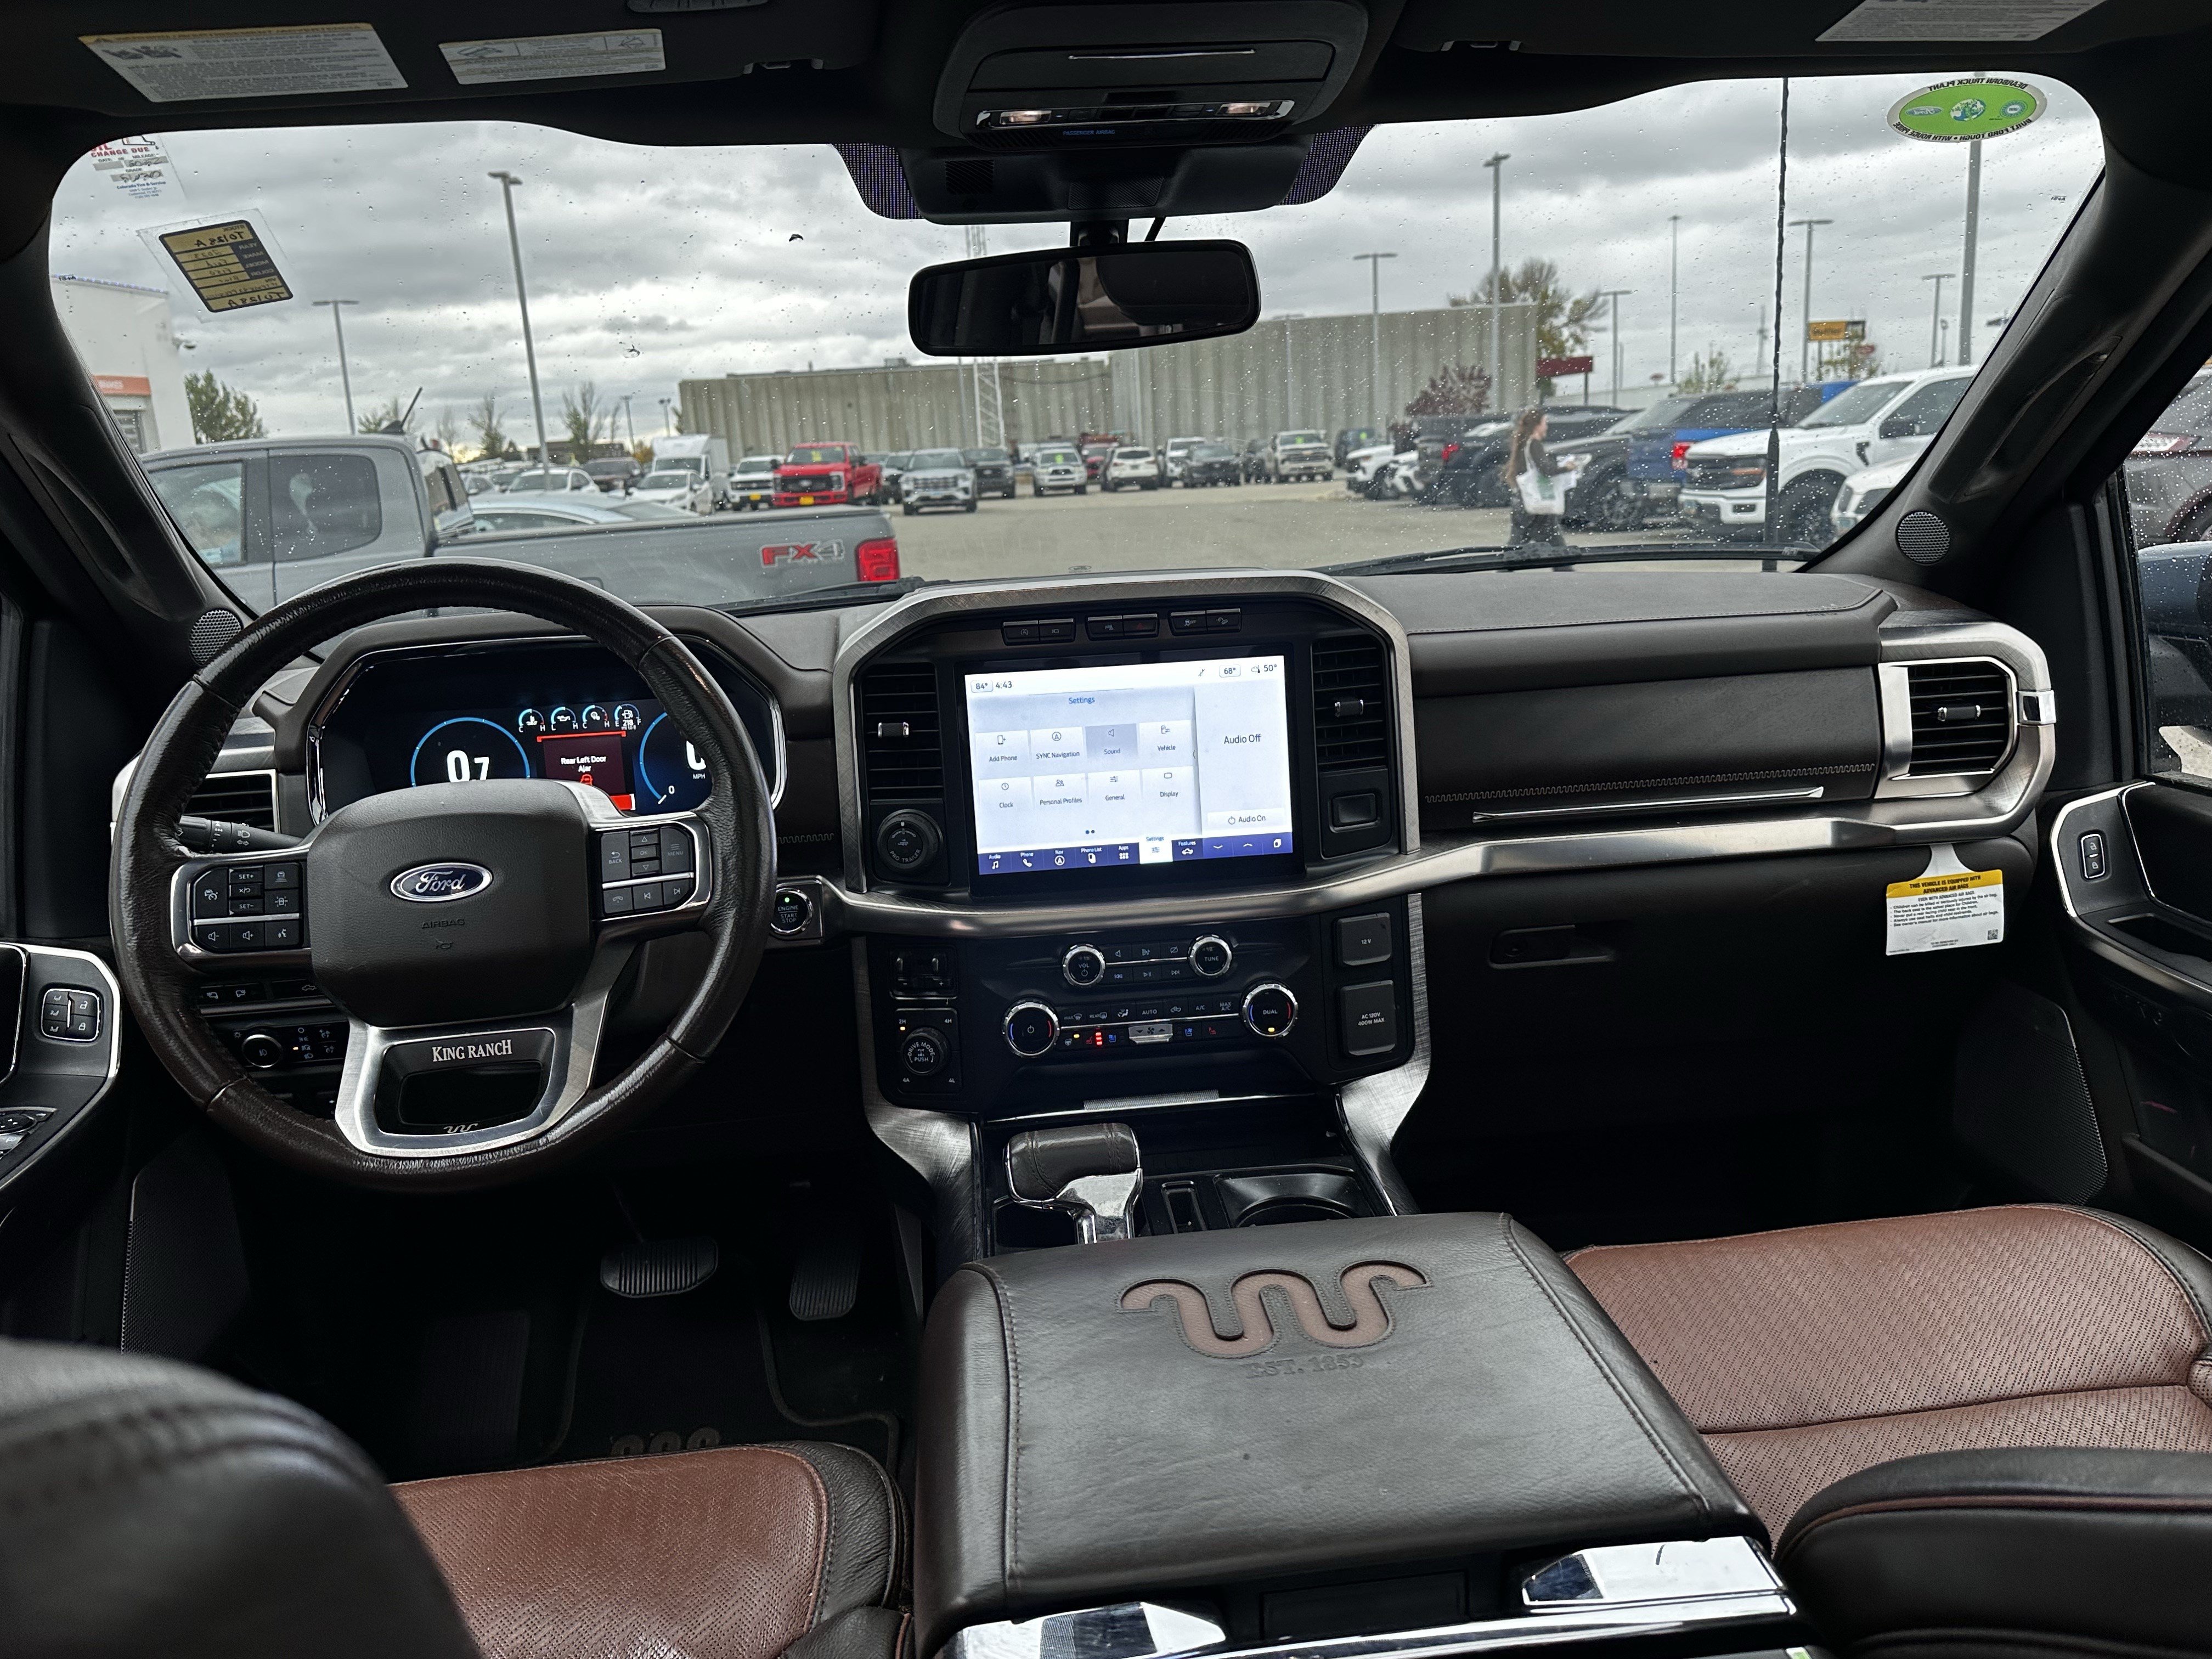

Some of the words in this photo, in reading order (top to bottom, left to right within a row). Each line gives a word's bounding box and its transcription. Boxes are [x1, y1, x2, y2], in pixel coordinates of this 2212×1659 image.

[91, 149, 128, 157] CHANGE
[759, 540, 845, 568] FX4
[995, 681, 1012, 689] 4:43
[1224, 735, 1247, 744] Audio
[1248, 734, 1261, 743] Off
[1051, 751, 1080, 759] Navigation
[447, 750, 489, 782] 07
[668, 785, 675, 794] 0
[890, 850, 900, 861] PRO
[901, 849, 921, 862] TRAILER
[415, 871, 466, 893] Ford
[421, 918, 466, 929] AIRBAG
[432, 1046, 465, 1062] KING
[467, 1039, 512, 1058] RANCH
[907, 1042, 919, 1056] DRIVE
[921, 1042, 935, 1056] MODE
[1240, 1359, 1306, 1379] EST.
[1308, 1353, 1364, 1373] 1853
